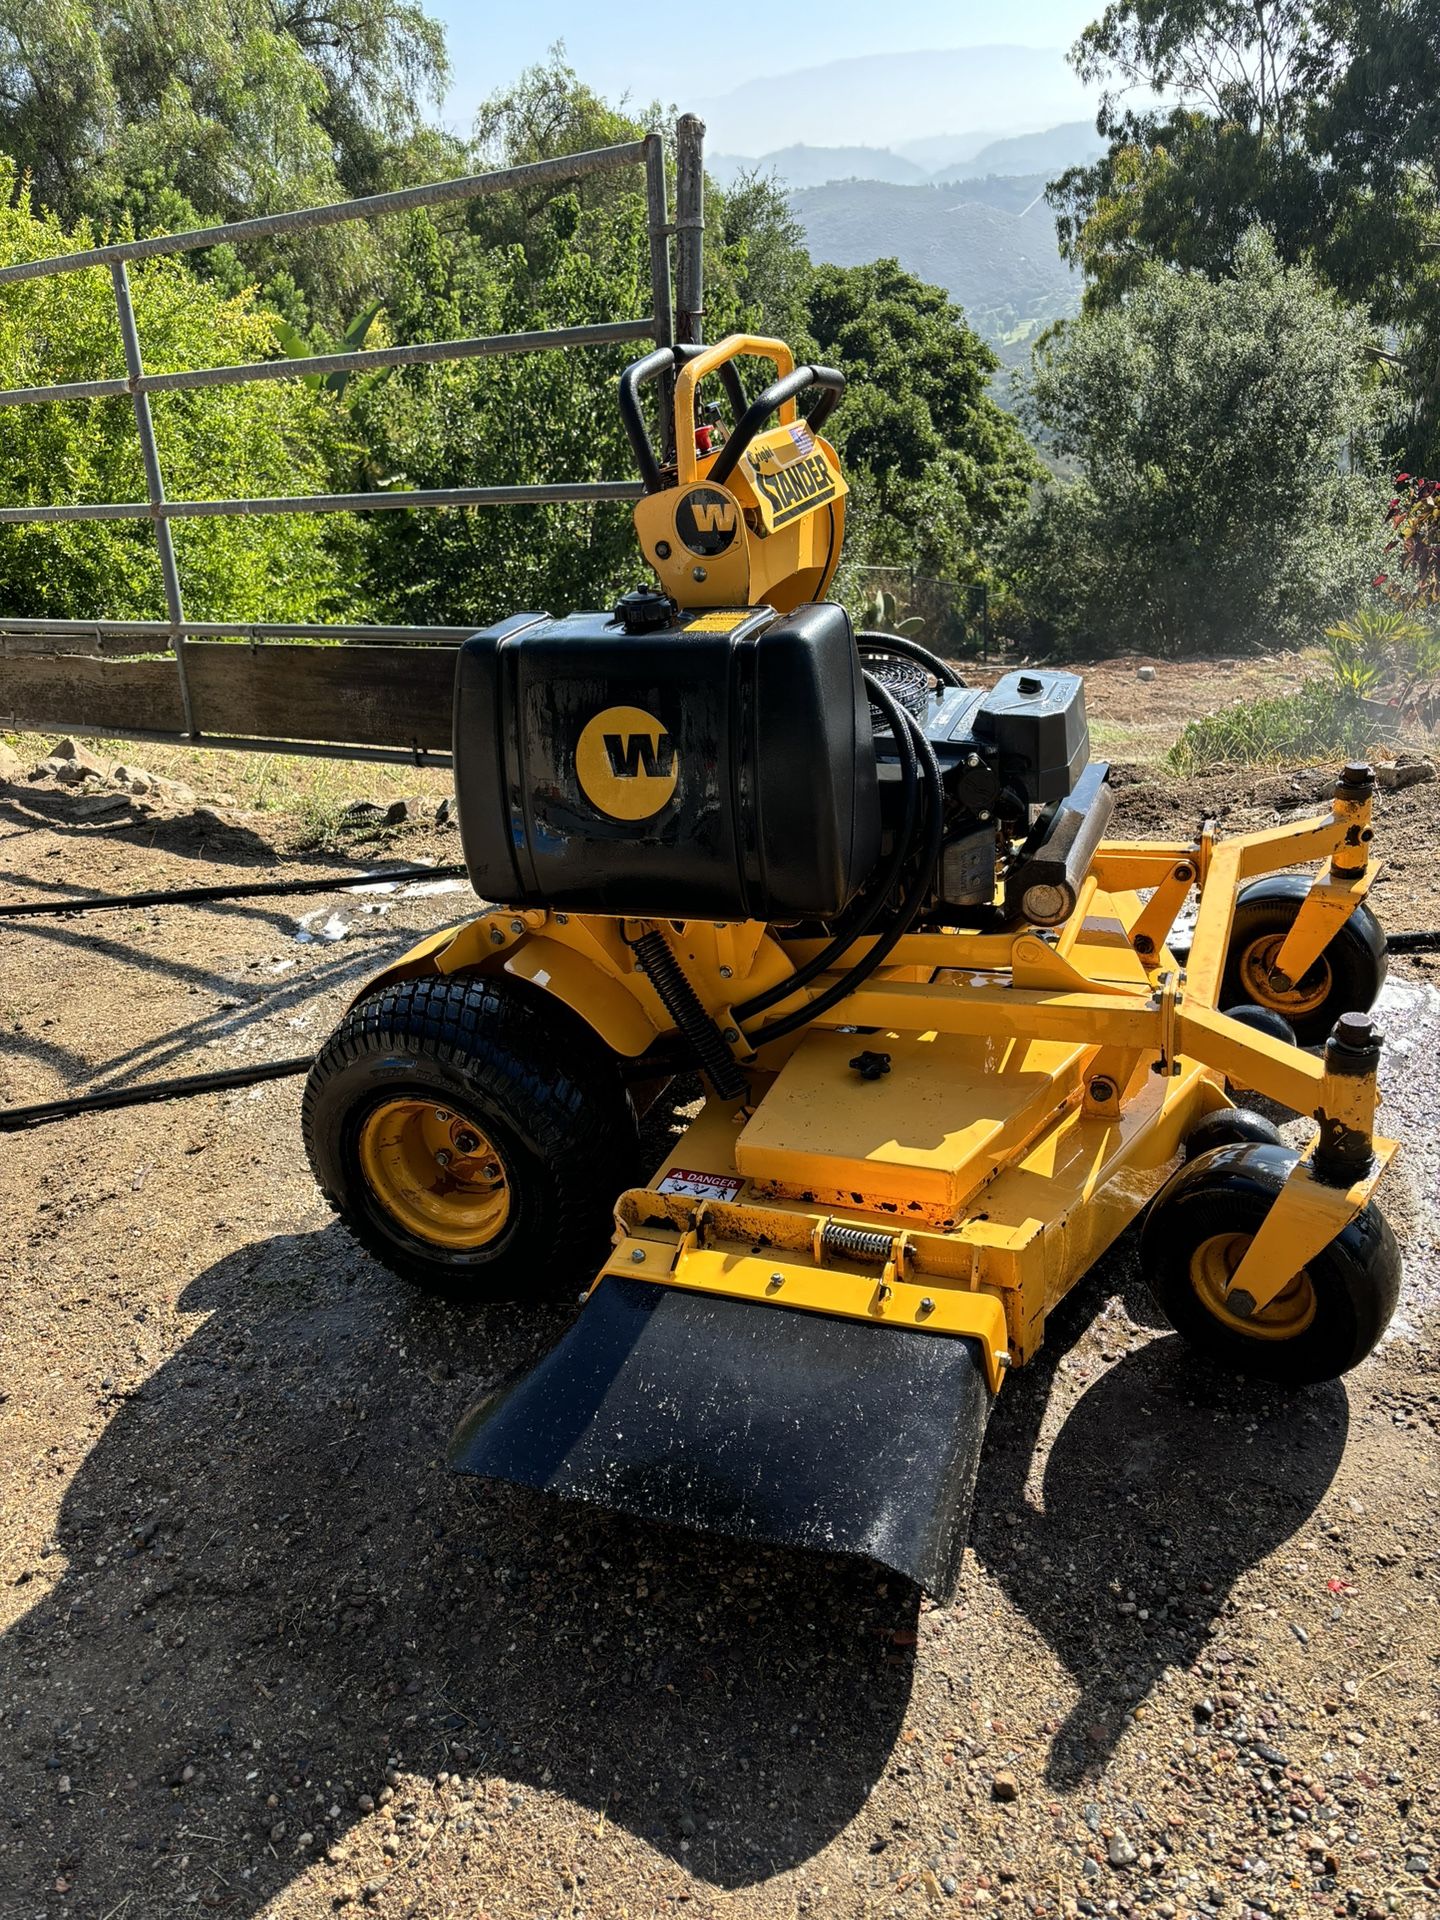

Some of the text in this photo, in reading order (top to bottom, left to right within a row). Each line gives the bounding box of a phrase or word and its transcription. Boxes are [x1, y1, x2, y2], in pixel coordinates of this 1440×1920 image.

[756, 454, 835, 514] STANDER
[691, 504, 737, 531] W
[603, 733, 676, 777] W
[687, 1173, 737, 1187] DANGER
